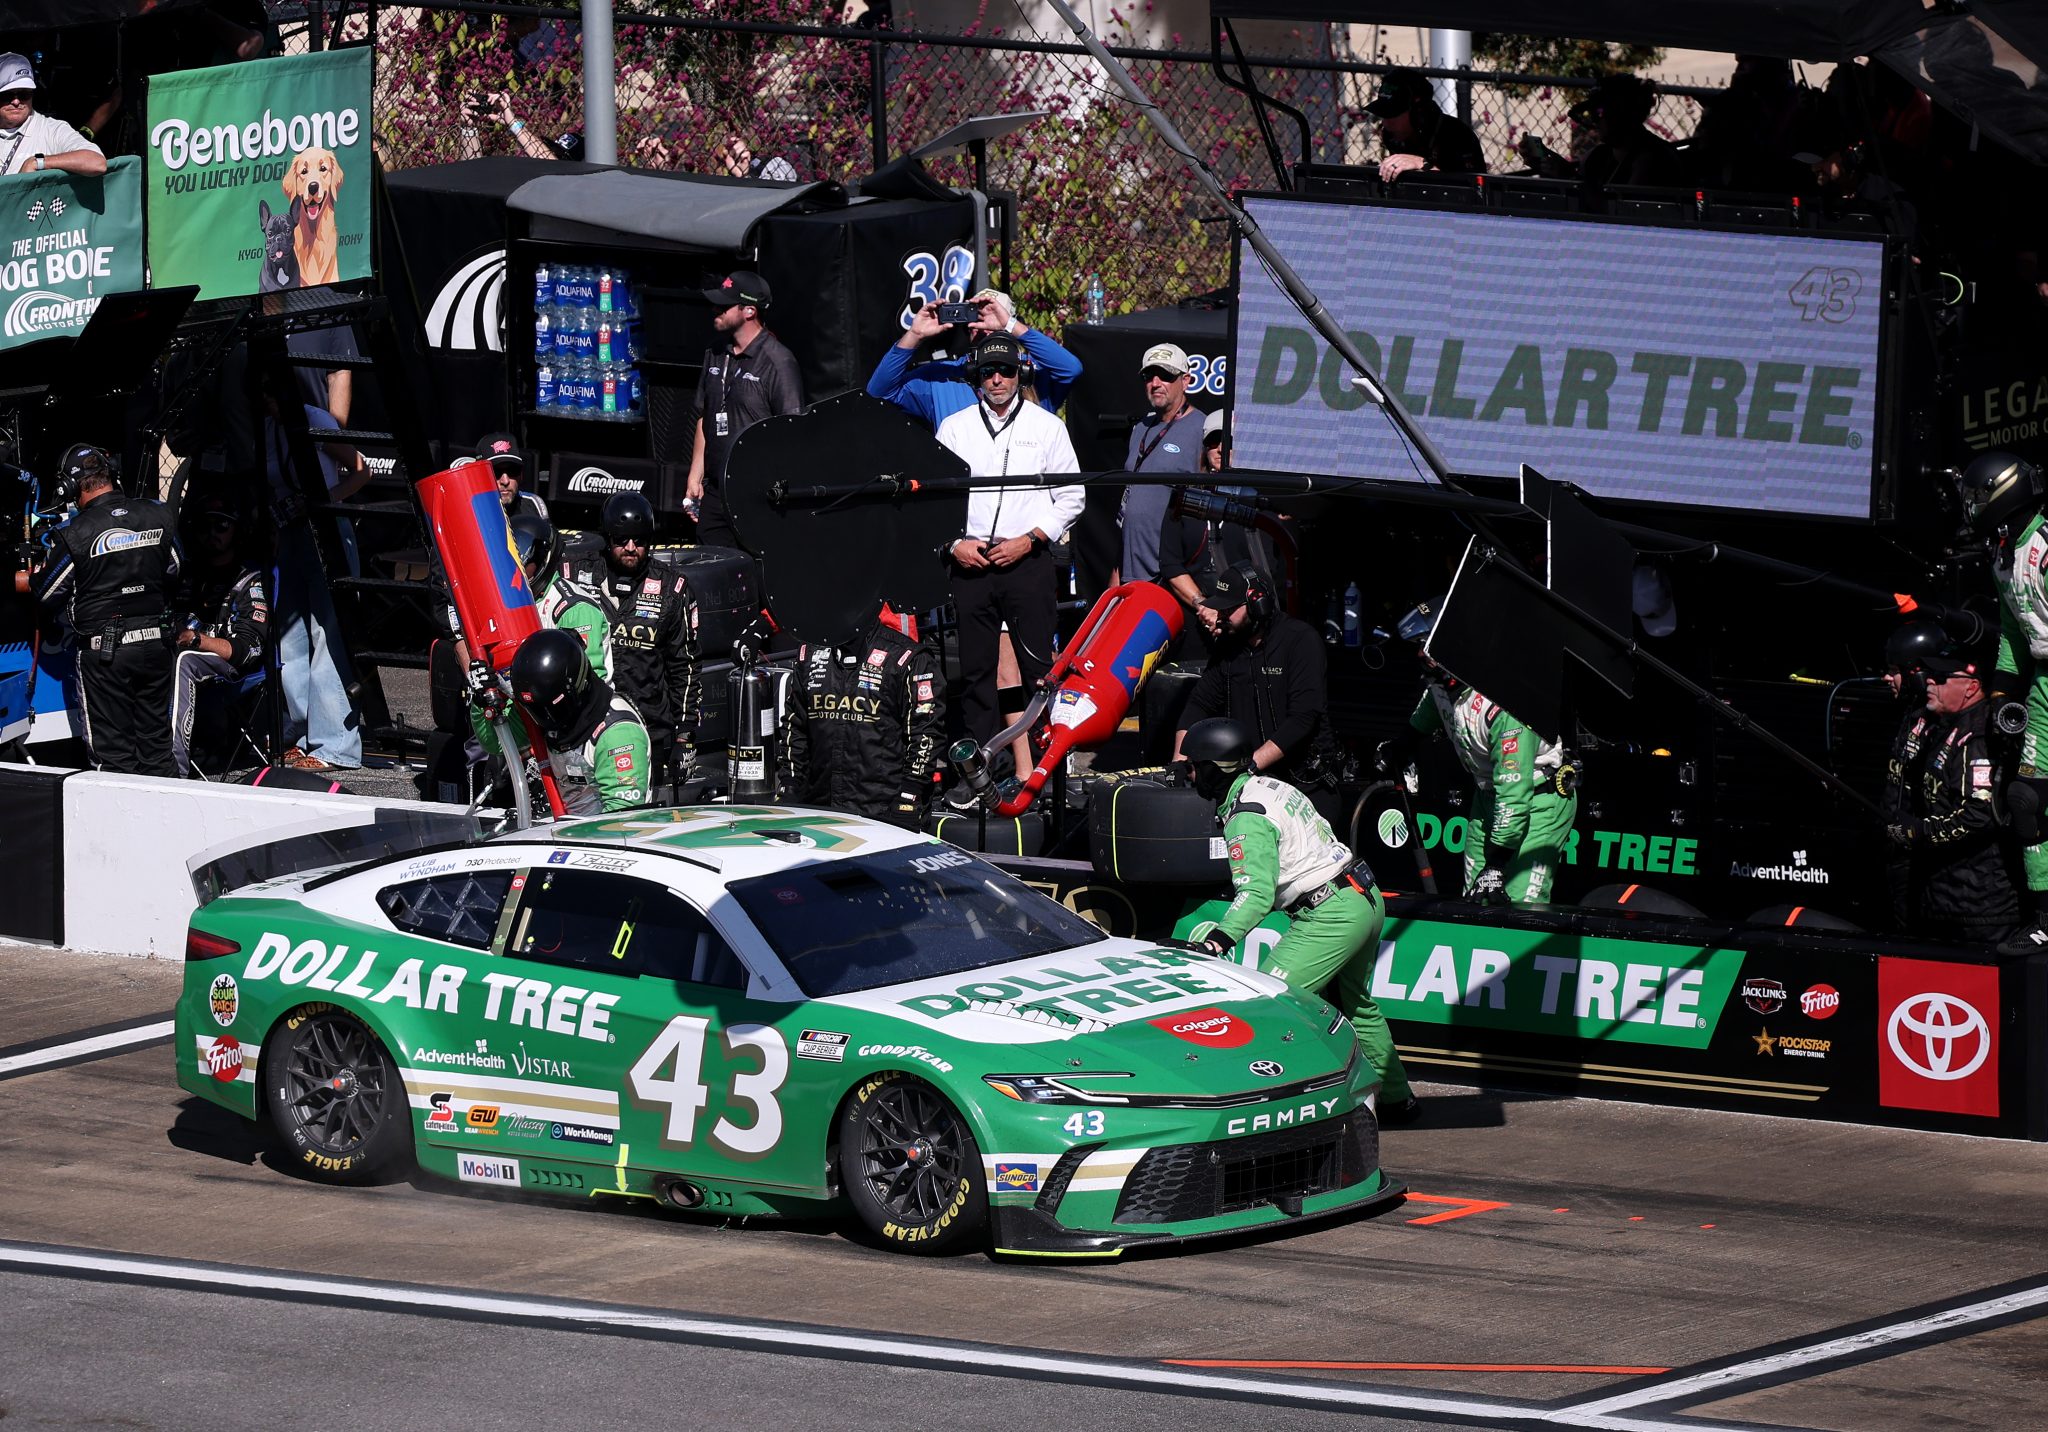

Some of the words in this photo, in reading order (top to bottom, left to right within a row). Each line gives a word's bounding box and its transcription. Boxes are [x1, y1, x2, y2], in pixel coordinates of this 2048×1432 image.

[151, 108, 359, 169] Benebone
[165, 173, 197, 194] YOU
[200, 166, 249, 190] LUCKY
[12, 239, 32, 257] THE
[36, 229, 88, 254] OFFICIAL
[238, 248, 263, 261] KYGO
[0, 258, 39, 291] OG
[555, 283, 594, 298] AQUAFINA
[900, 245, 975, 331] 38
[1788, 266, 1862, 323] 43
[555, 333, 592, 347] AQUAFINA
[1185, 354, 1226, 395] 38
[1251, 325, 1619, 431] DOLLAR
[558, 384, 596, 398] AQUAFINA
[1963, 376, 2048, 431] LEGA
[1990, 420, 2039, 447] MOTOR
[613, 623, 659, 642] ACY
[619, 638, 640, 649] CLUB
[808, 694, 881, 715] EGACY
[842, 712, 863, 721] CLUB
[408, 858, 436, 870] CLUB
[484, 856, 521, 866] Protected
[908, 851, 973, 874] JONES
[1594, 830, 1699, 875] TREE
[399, 862, 456, 880] WYNDHAM
[1730, 861, 1829, 884] AdventHealth
[213, 987, 235, 1000] SOUR
[242, 931, 468, 1014] DOLLAR
[482, 972, 621, 1042] TREE
[896, 948, 1211, 1020] DOLLAR
[1533, 954, 1704, 1028] TREE
[1741, 986, 1763, 998] JACK
[213, 1000, 235, 1013] PATCH
[1011, 972, 1230, 1027] TREE
[1800, 990, 1839, 1014] Fritos
[1172, 1015, 1231, 1034] Colgate
[803, 1044, 816, 1052] CUP
[816, 1045, 838, 1054] SERIES
[816, 1033, 843, 1044] NASCAR
[1779, 1036, 1831, 1051] ROCKSTAR
[206, 1043, 243, 1075] Fritos
[413, 1047, 506, 1070] AdventHealth
[511, 1044, 574, 1078] VISTAR
[858, 1045, 953, 1074] GOODYEAR
[1783, 1048, 1807, 1057] ENERGY
[1807, 1050, 1825, 1059] DRINK
[628, 1014, 790, 1155] 43
[857, 1070, 901, 1104] EAGLE
[470, 1109, 498, 1123] GW
[504, 1111, 547, 1137] Massey
[1063, 1110, 1106, 1138] 43
[1227, 1097, 1340, 1135] CAMRY
[564, 1126, 613, 1143] WorkMoney
[303, 1149, 352, 1171] EAGLE
[463, 1160, 500, 1178] Mobil
[504, 1166, 513, 1179] 1
[996, 1171, 1038, 1184] SUNOCO
[882, 1177, 970, 1241] GOODYEAR
